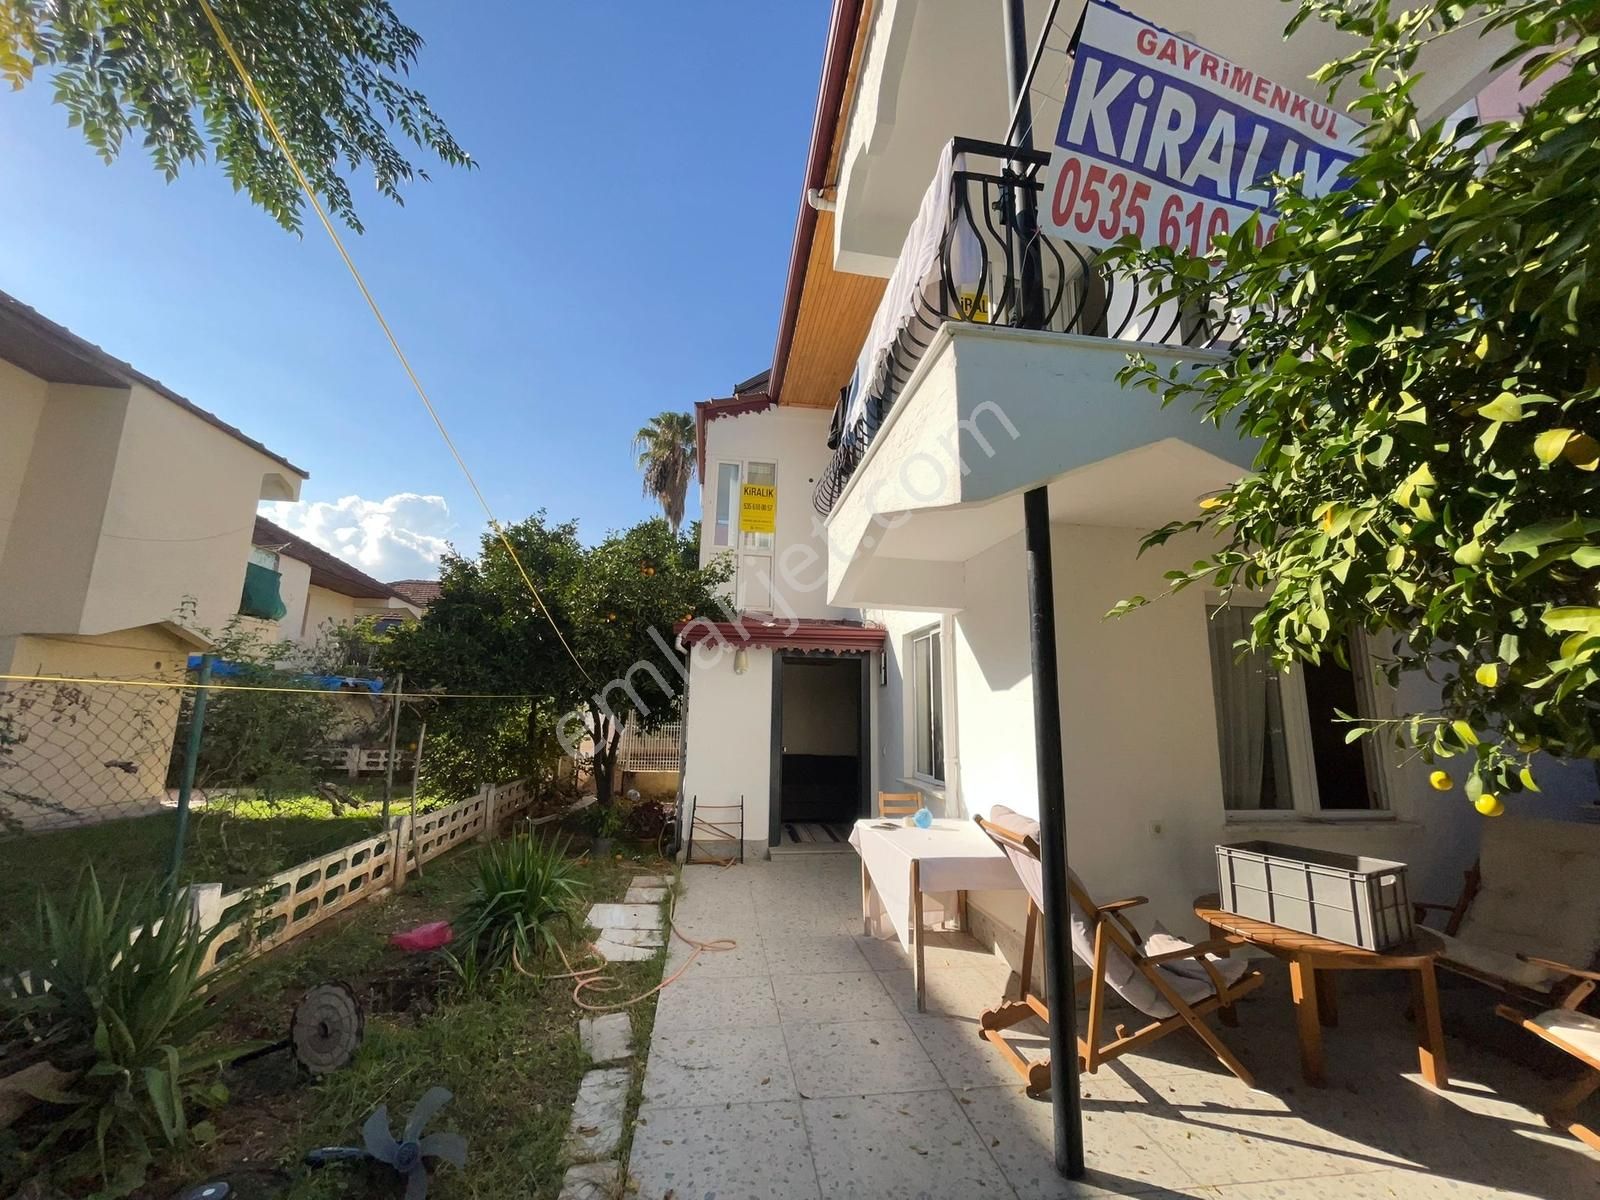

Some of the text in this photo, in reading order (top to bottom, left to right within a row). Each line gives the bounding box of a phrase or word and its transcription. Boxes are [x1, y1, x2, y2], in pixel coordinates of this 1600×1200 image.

[1136, 28, 1339, 140] GAYRiMENKUL
[1051, 157, 1152, 241] 0535
[1159, 194, 1230, 266] 610
